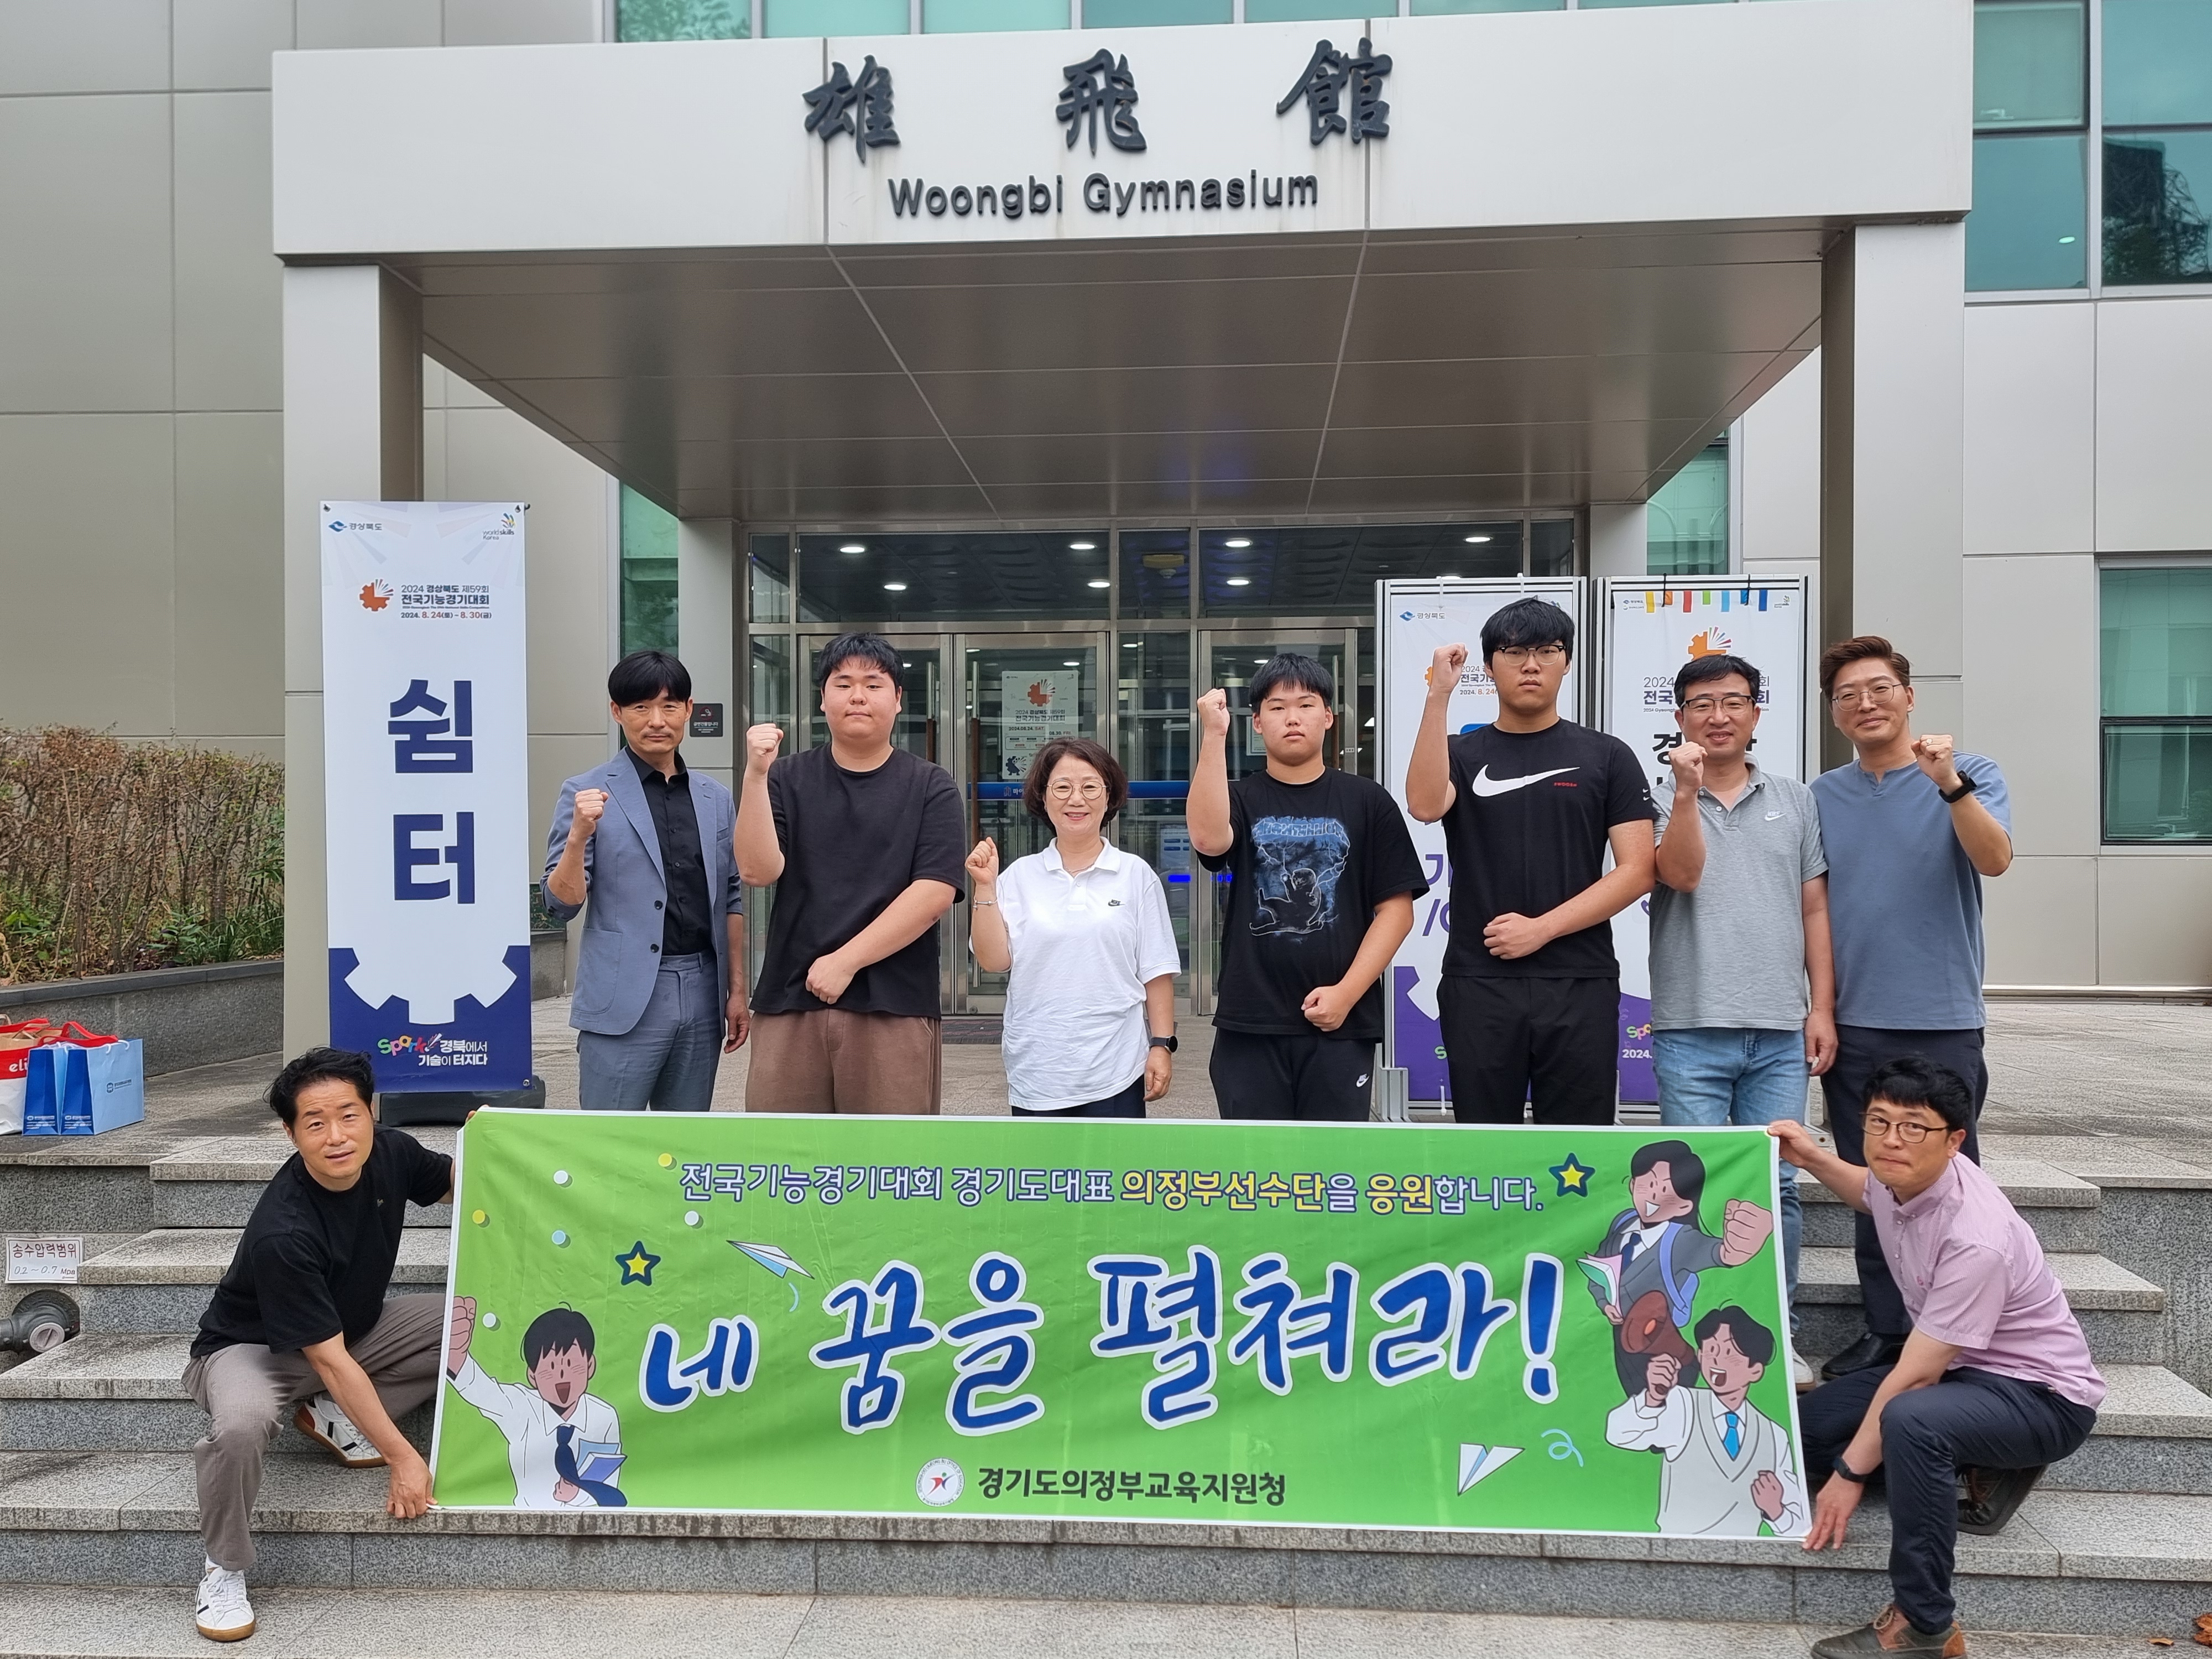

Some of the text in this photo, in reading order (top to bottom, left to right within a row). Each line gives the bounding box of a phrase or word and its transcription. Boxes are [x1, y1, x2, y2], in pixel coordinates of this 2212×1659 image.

[888, 169, 1318, 218] Woongbi Gymnasium
[401, 585, 424, 593] 2024
[426, 585, 460, 593] 경상북도
[401, 594, 489, 605] 전국기능경기대회
[1644, 677, 1675, 687] 2024
[388, 679, 475, 904] 쉼터
[440, 1040, 487, 1053] 경북에서
[1622, 1049, 1652, 1058] 2024.
[419, 1053, 488, 1066] 기술이 터지다
[680, 1163, 1545, 1215] 전국기능경기대회 경기도대표 의정부선수단을 응원합니다.
[13, 1243, 76, 1259] 송수압력범위
[639, 1245, 1565, 1437] 네 꿈을 펼쳐라!
[978, 1468, 1286, 1507] 경기도의정부교육지원청
